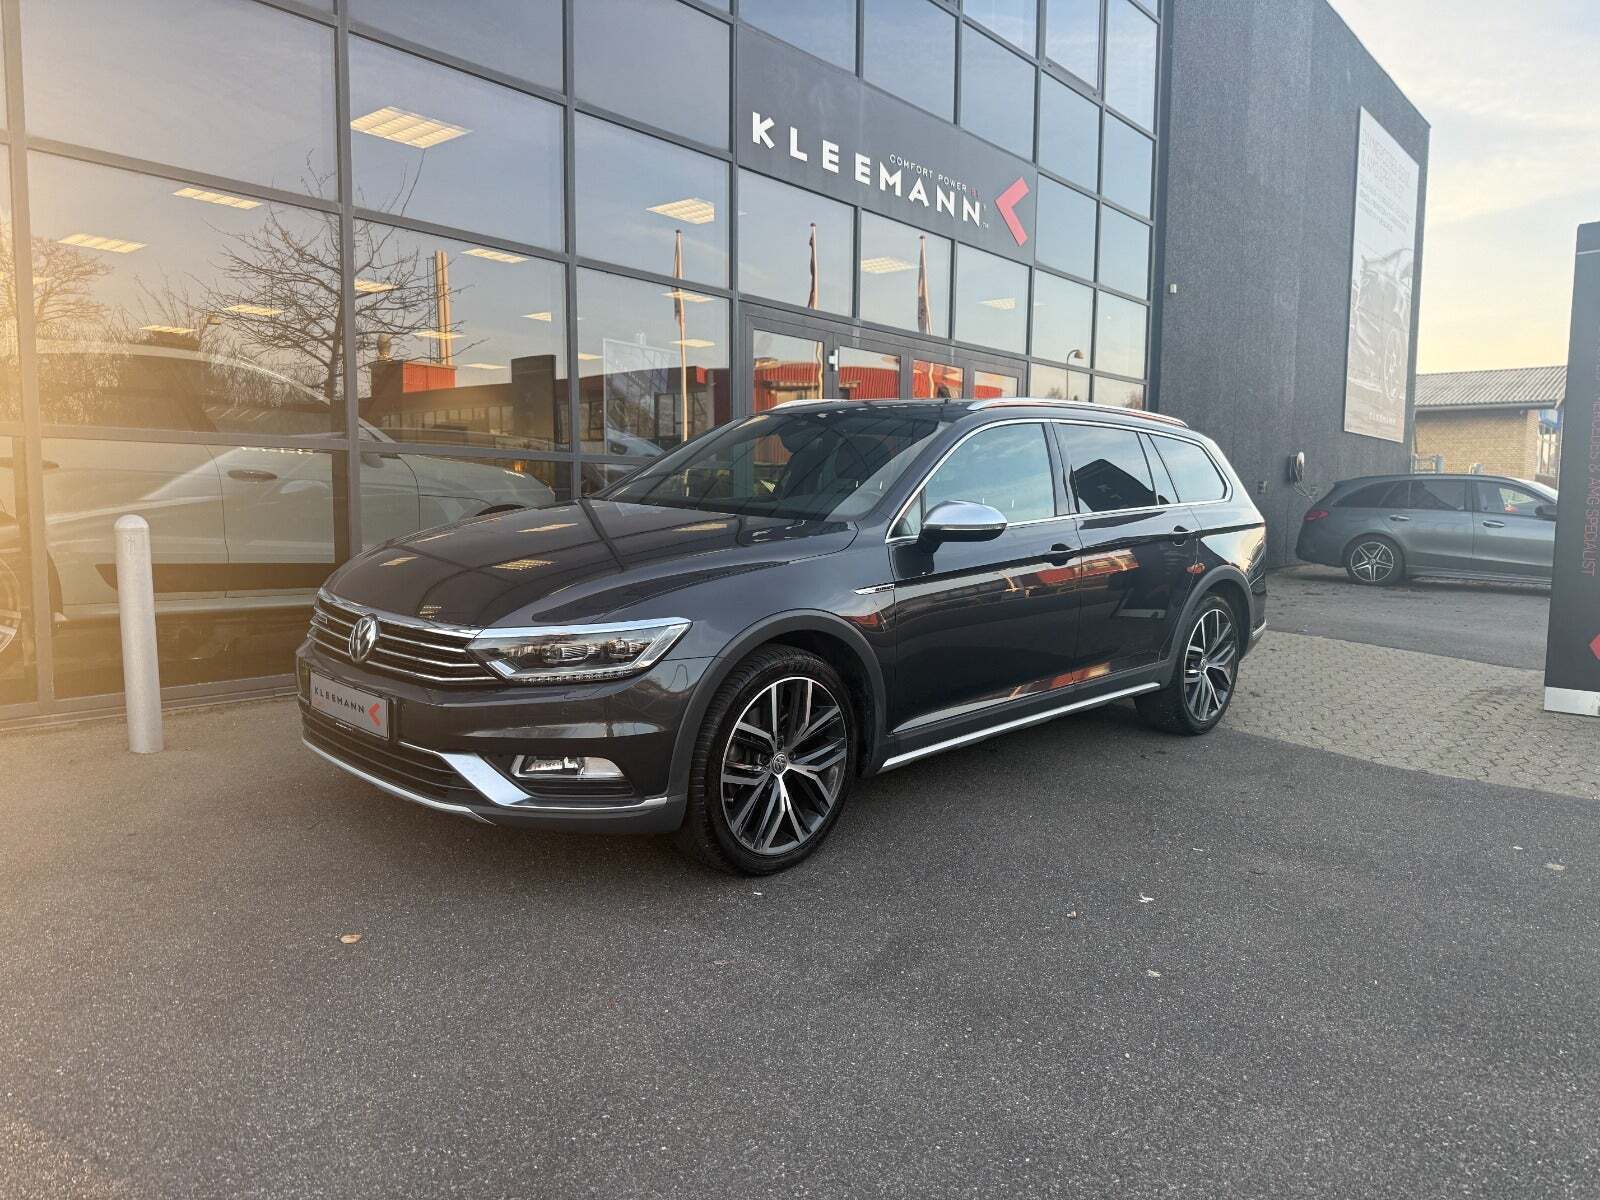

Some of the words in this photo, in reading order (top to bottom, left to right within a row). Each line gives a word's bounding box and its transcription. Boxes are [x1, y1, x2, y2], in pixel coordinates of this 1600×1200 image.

[752, 111, 980, 228] KLEEMANN
[889, 153, 934, 179] COMFORT
[938, 173, 967, 193] POWER
[1582, 509, 1599, 577] SPECIALIST
[314, 686, 365, 715] KLEEMANN
